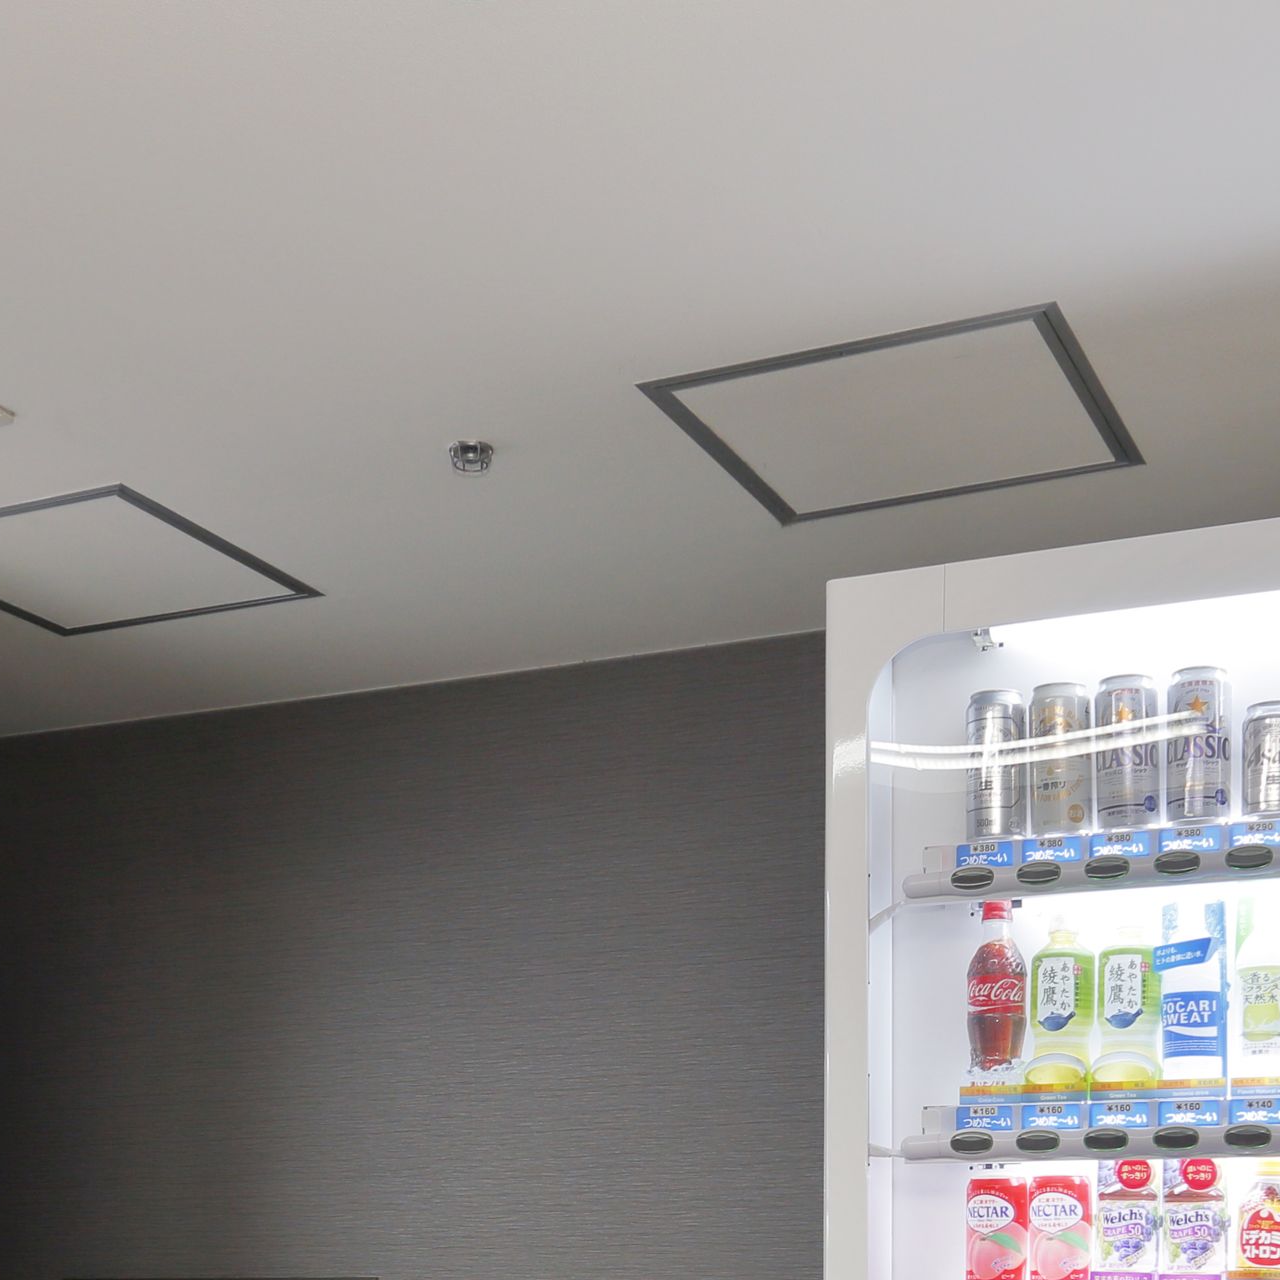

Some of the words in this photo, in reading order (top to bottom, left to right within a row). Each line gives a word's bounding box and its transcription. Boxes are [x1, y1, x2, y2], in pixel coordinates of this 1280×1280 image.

[1167, 735, 1230, 764] CLASSIC
[1096, 744, 1158, 772] CLASSIC
[978, 780, 993, 791] 生
[1248, 822, 1273, 831] ¥290
[1176, 828, 1201, 838] ¥380
[972, 844, 995, 852] ¥380
[1040, 966, 1059, 1006] 綾鷹
[1059, 961, 1070, 1010] あやたか
[1108, 964, 1126, 1005] 綾鷹
[1127, 960, 1138, 1009] あやたか
[1243, 992, 1278, 1005] 天然水
[1162, 1000, 1217, 1014] POCARI
[1162, 1012, 1211, 1025] SWEAT
[972, 1107, 996, 1116] ¥160
[1106, 1103, 1131, 1112] ¥160
[1176, 1102, 1201, 1112] ¥160
[1121, 1172, 1147, 1180] すっきり
[1186, 1172, 1211, 1180] すっきり
[1127, 1225, 1142, 1236] 50
[1194, 1226, 1207, 1237] 50
